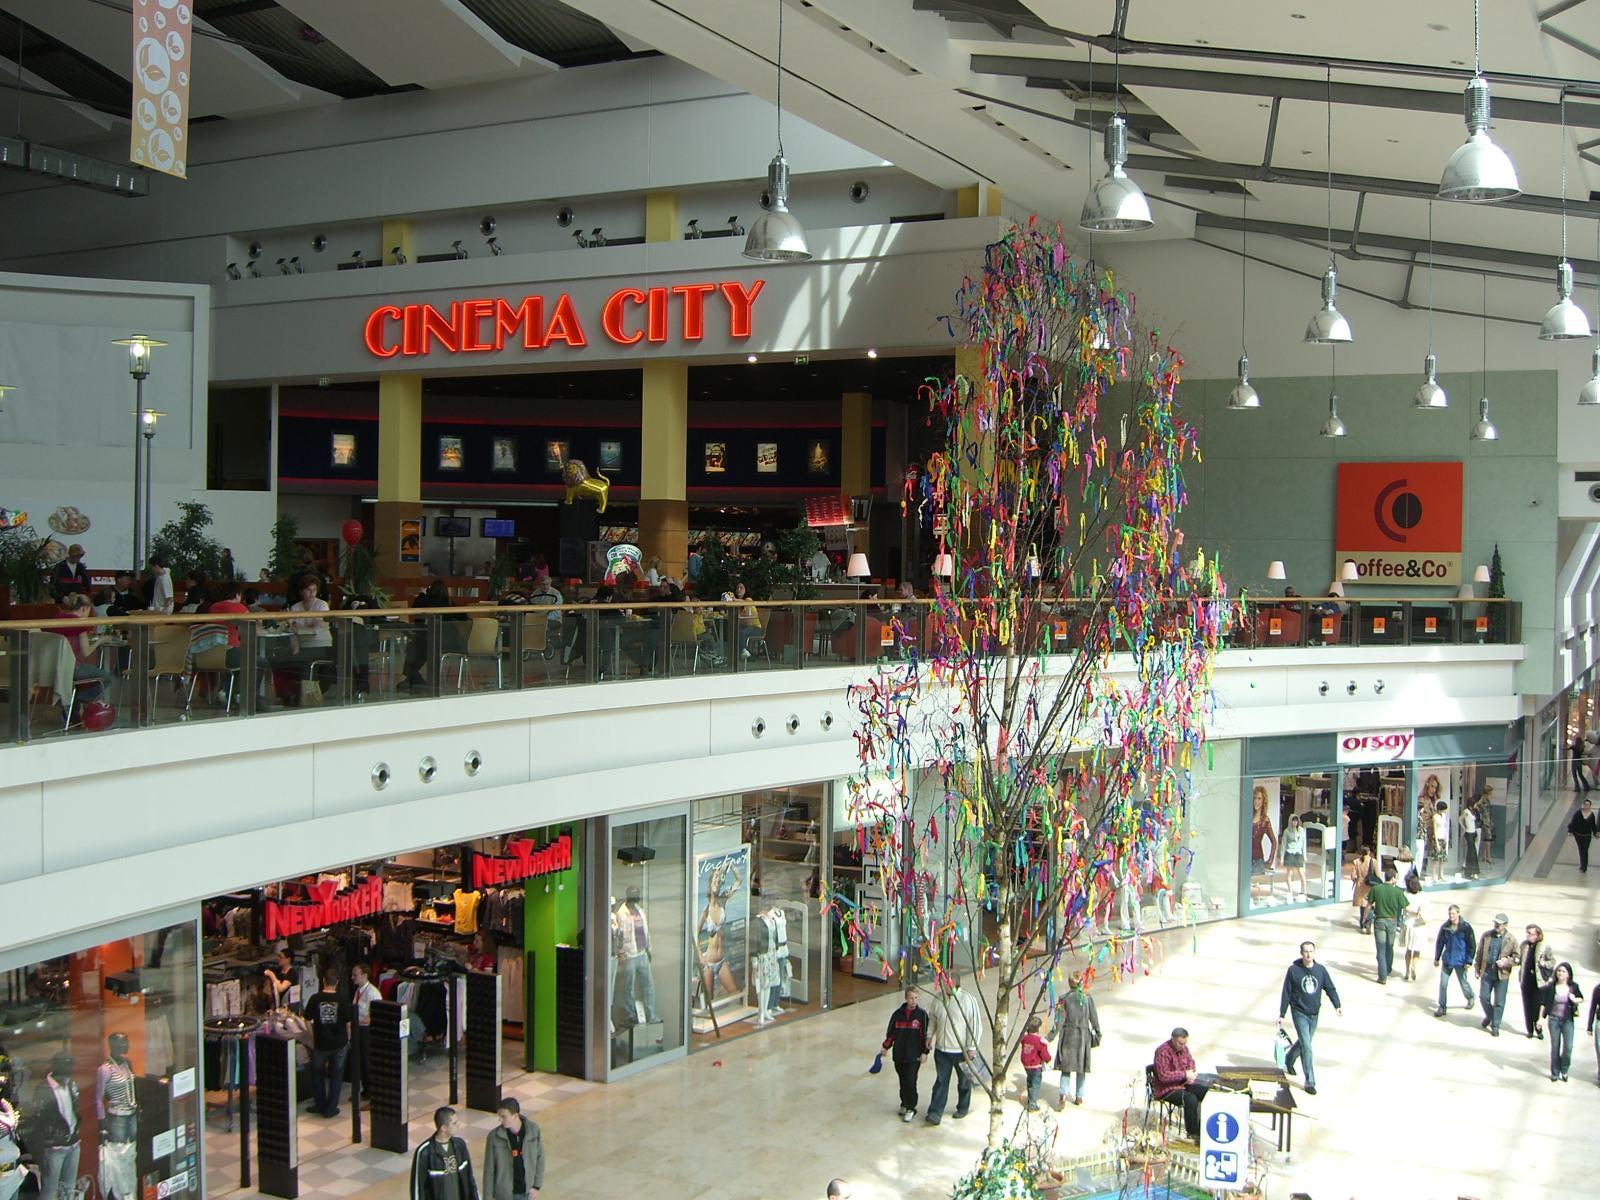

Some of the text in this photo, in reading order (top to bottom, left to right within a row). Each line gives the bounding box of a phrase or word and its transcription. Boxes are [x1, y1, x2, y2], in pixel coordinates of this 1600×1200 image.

[363, 279, 766, 360] CINEMA CITY
[1343, 558, 1447, 578] offee&Co
[1342, 734, 1414, 760] orsay
